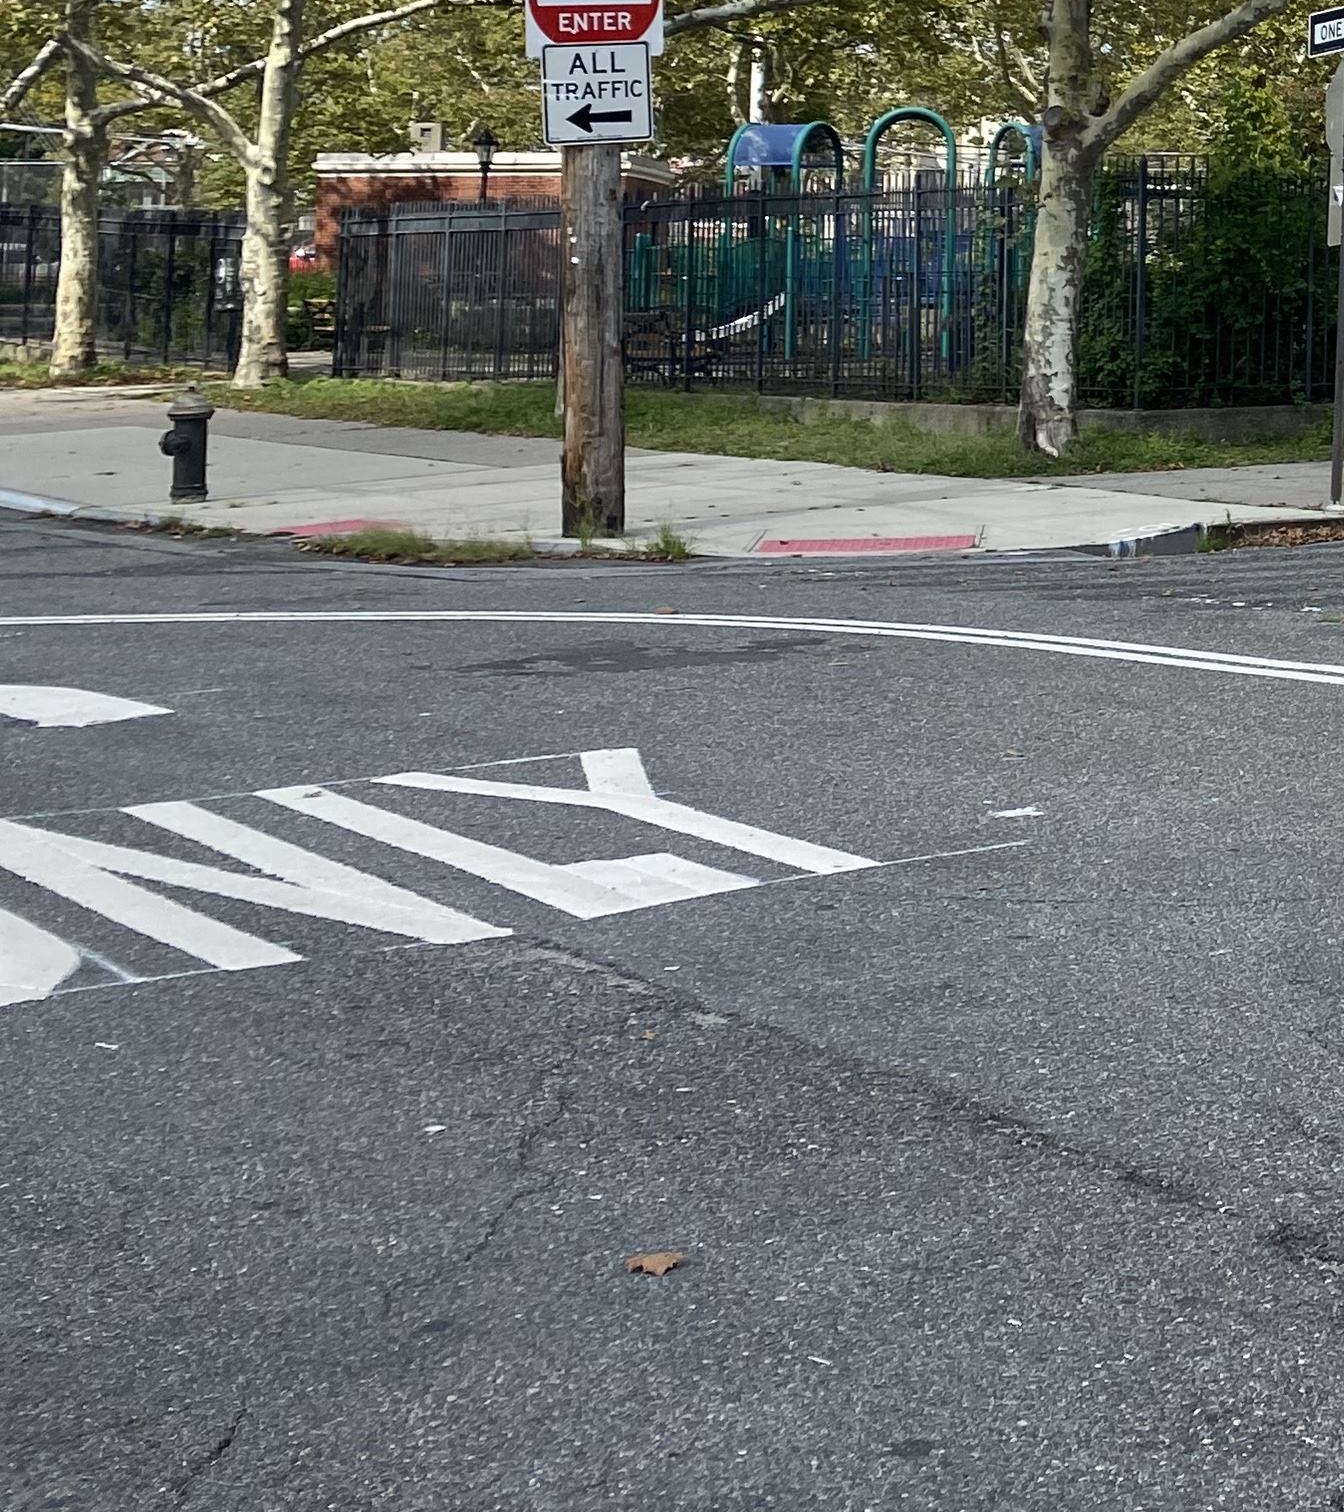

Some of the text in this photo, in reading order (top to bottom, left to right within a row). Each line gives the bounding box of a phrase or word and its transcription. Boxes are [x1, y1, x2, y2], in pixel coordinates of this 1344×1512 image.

[558, 11, 632, 34] ENTER
[1321, 21, 1342, 40] ONE
[568, 51, 627, 76] ALL
[550, 79, 644, 101] TRAFFIC
[0, 747, 881, 1006] NLY
